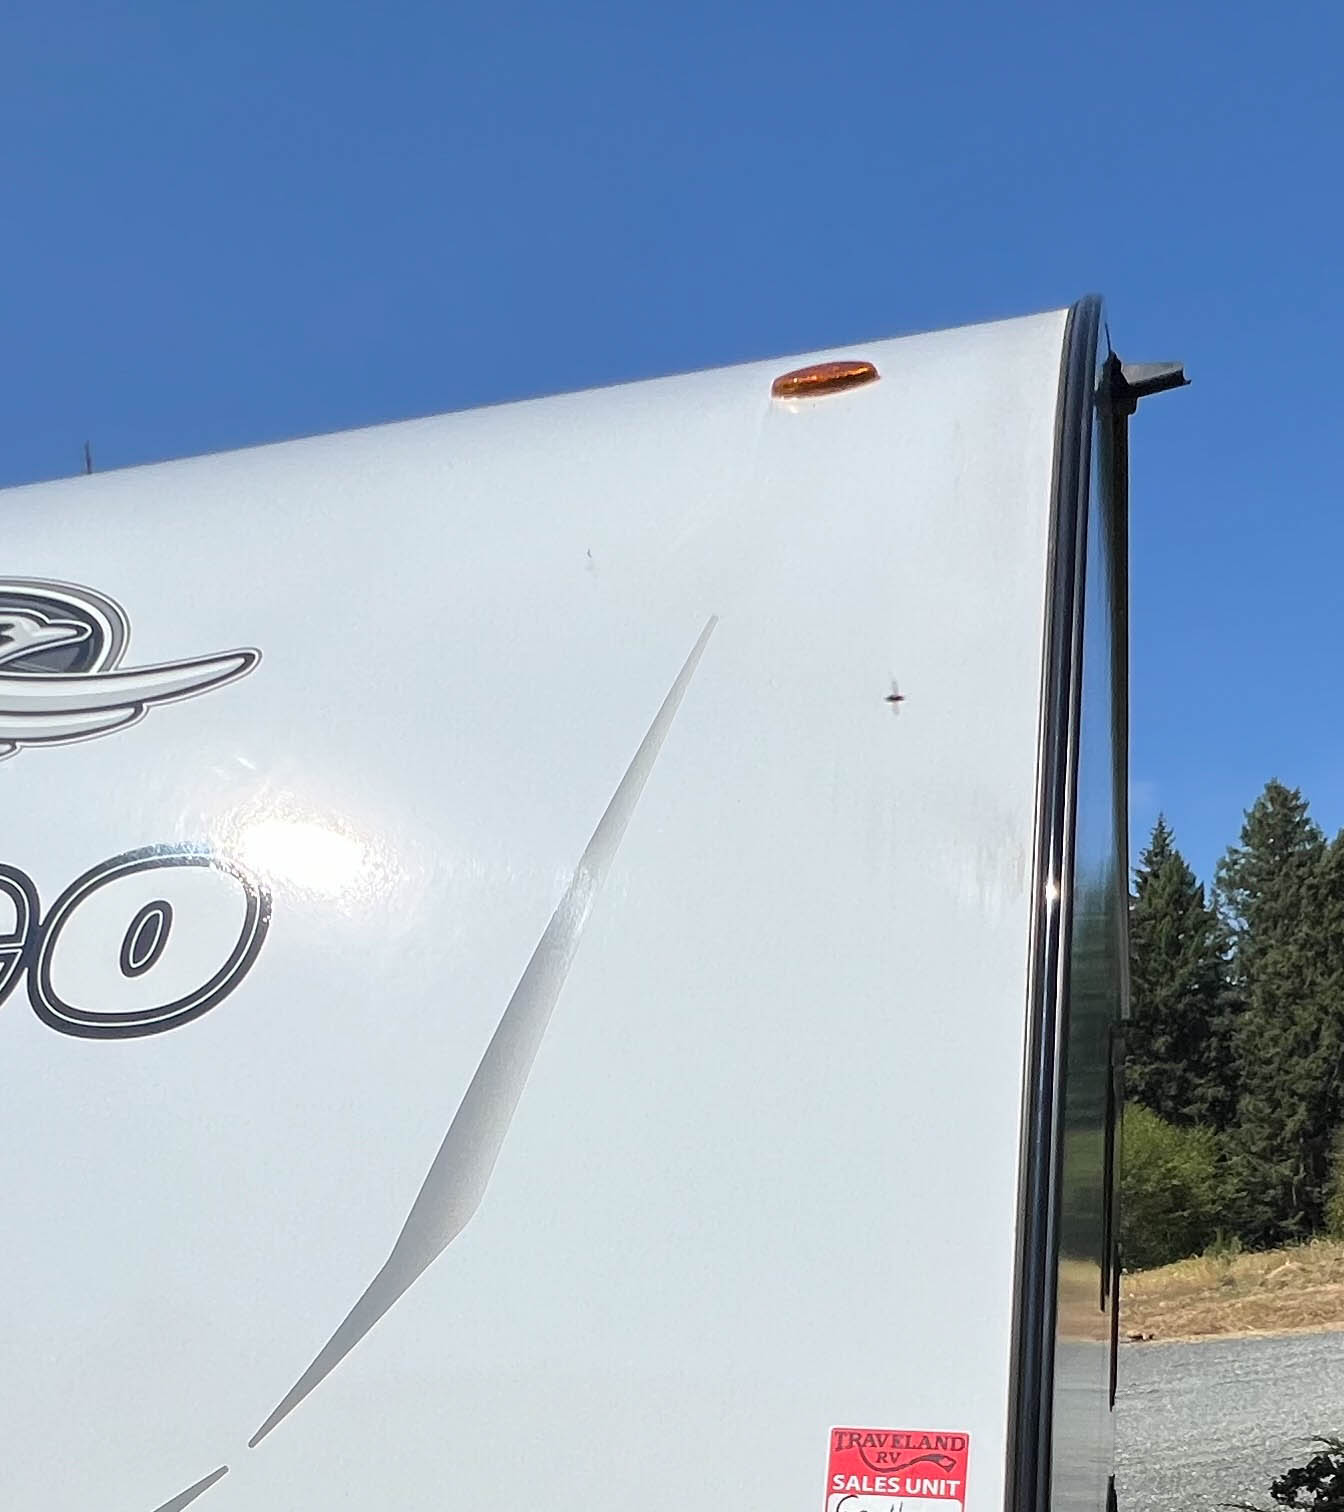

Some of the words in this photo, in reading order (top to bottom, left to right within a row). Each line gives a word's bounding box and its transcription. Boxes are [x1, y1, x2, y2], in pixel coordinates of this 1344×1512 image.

[834, 1431, 966, 1451] TRAVELAND
[876, 1451, 901, 1464] RV
[832, 1474, 900, 1493] SALES
[905, 1478, 960, 1496] UNIT
